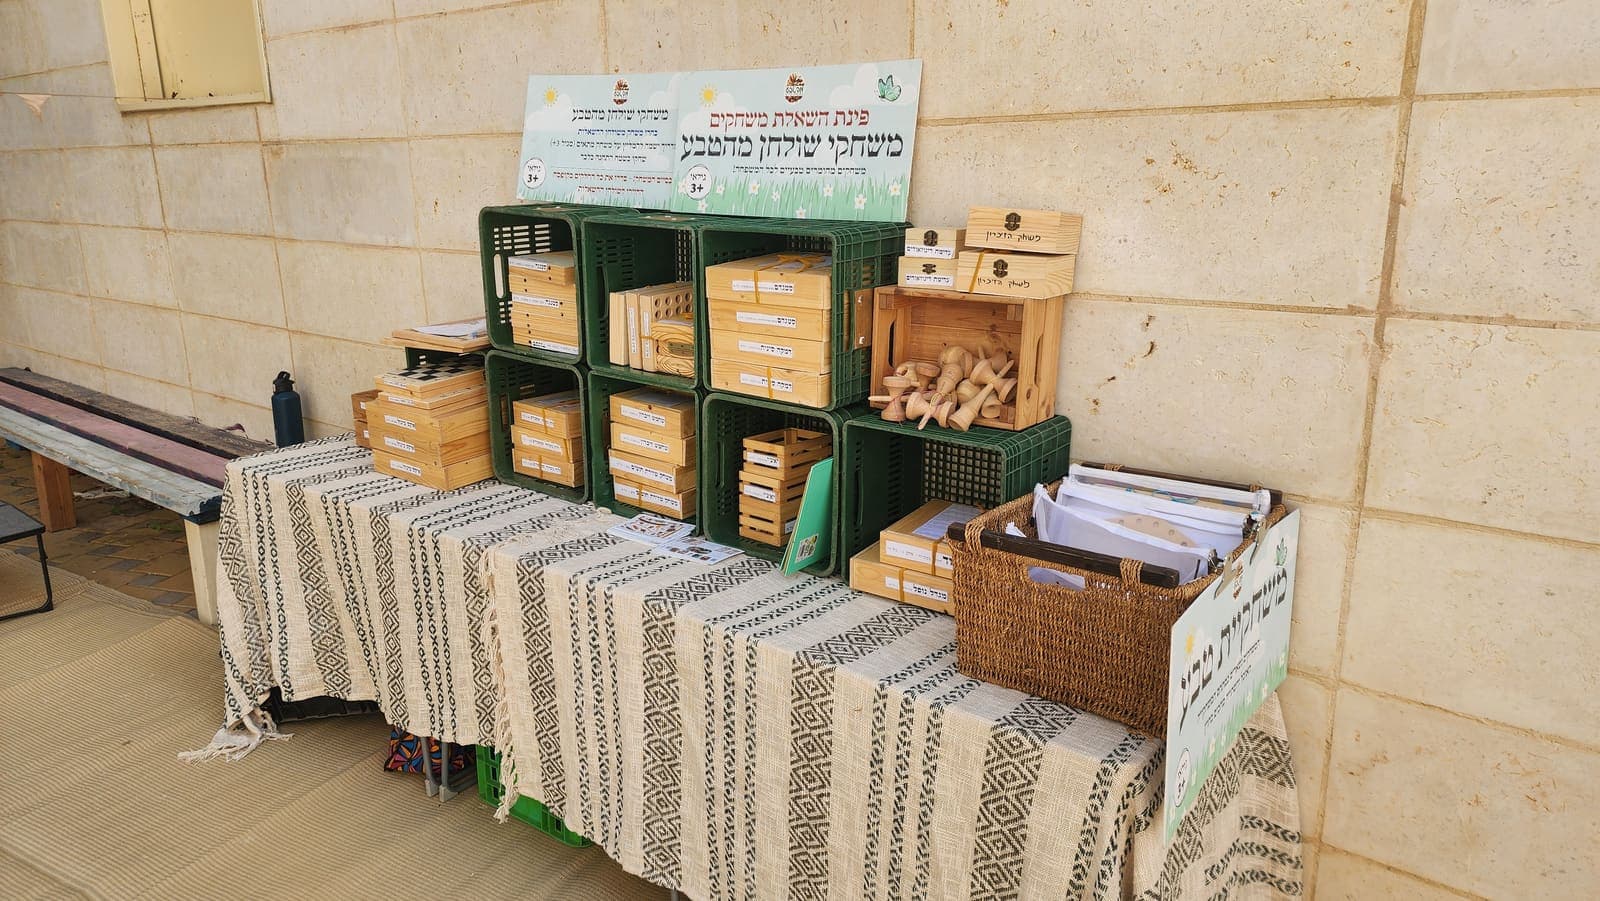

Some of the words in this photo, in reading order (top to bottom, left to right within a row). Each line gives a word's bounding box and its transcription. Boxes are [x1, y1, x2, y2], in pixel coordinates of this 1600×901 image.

[571, 109, 605, 122] מהטבע
[608, 109, 636, 122] שולחן
[638, 109, 669, 124] משחקי
[710, 112, 769, 133] משחקים
[772, 110, 830, 128] השאלת
[833, 108, 871, 127] פינת
[680, 134, 753, 161] מהטבע
[760, 133, 822, 164] שולחן
[829, 133, 904, 166] משחקי
[527, 174, 539, 183] 3+
[838, 166, 867, 177] משחקים
[690, 183, 704, 193] 3+
[913, 583, 928, 595] נופל
[930, 588, 948, 601] מגדל
[1218, 566, 1288, 672] משחקיית
[1178, 643, 1215, 736] טבע
